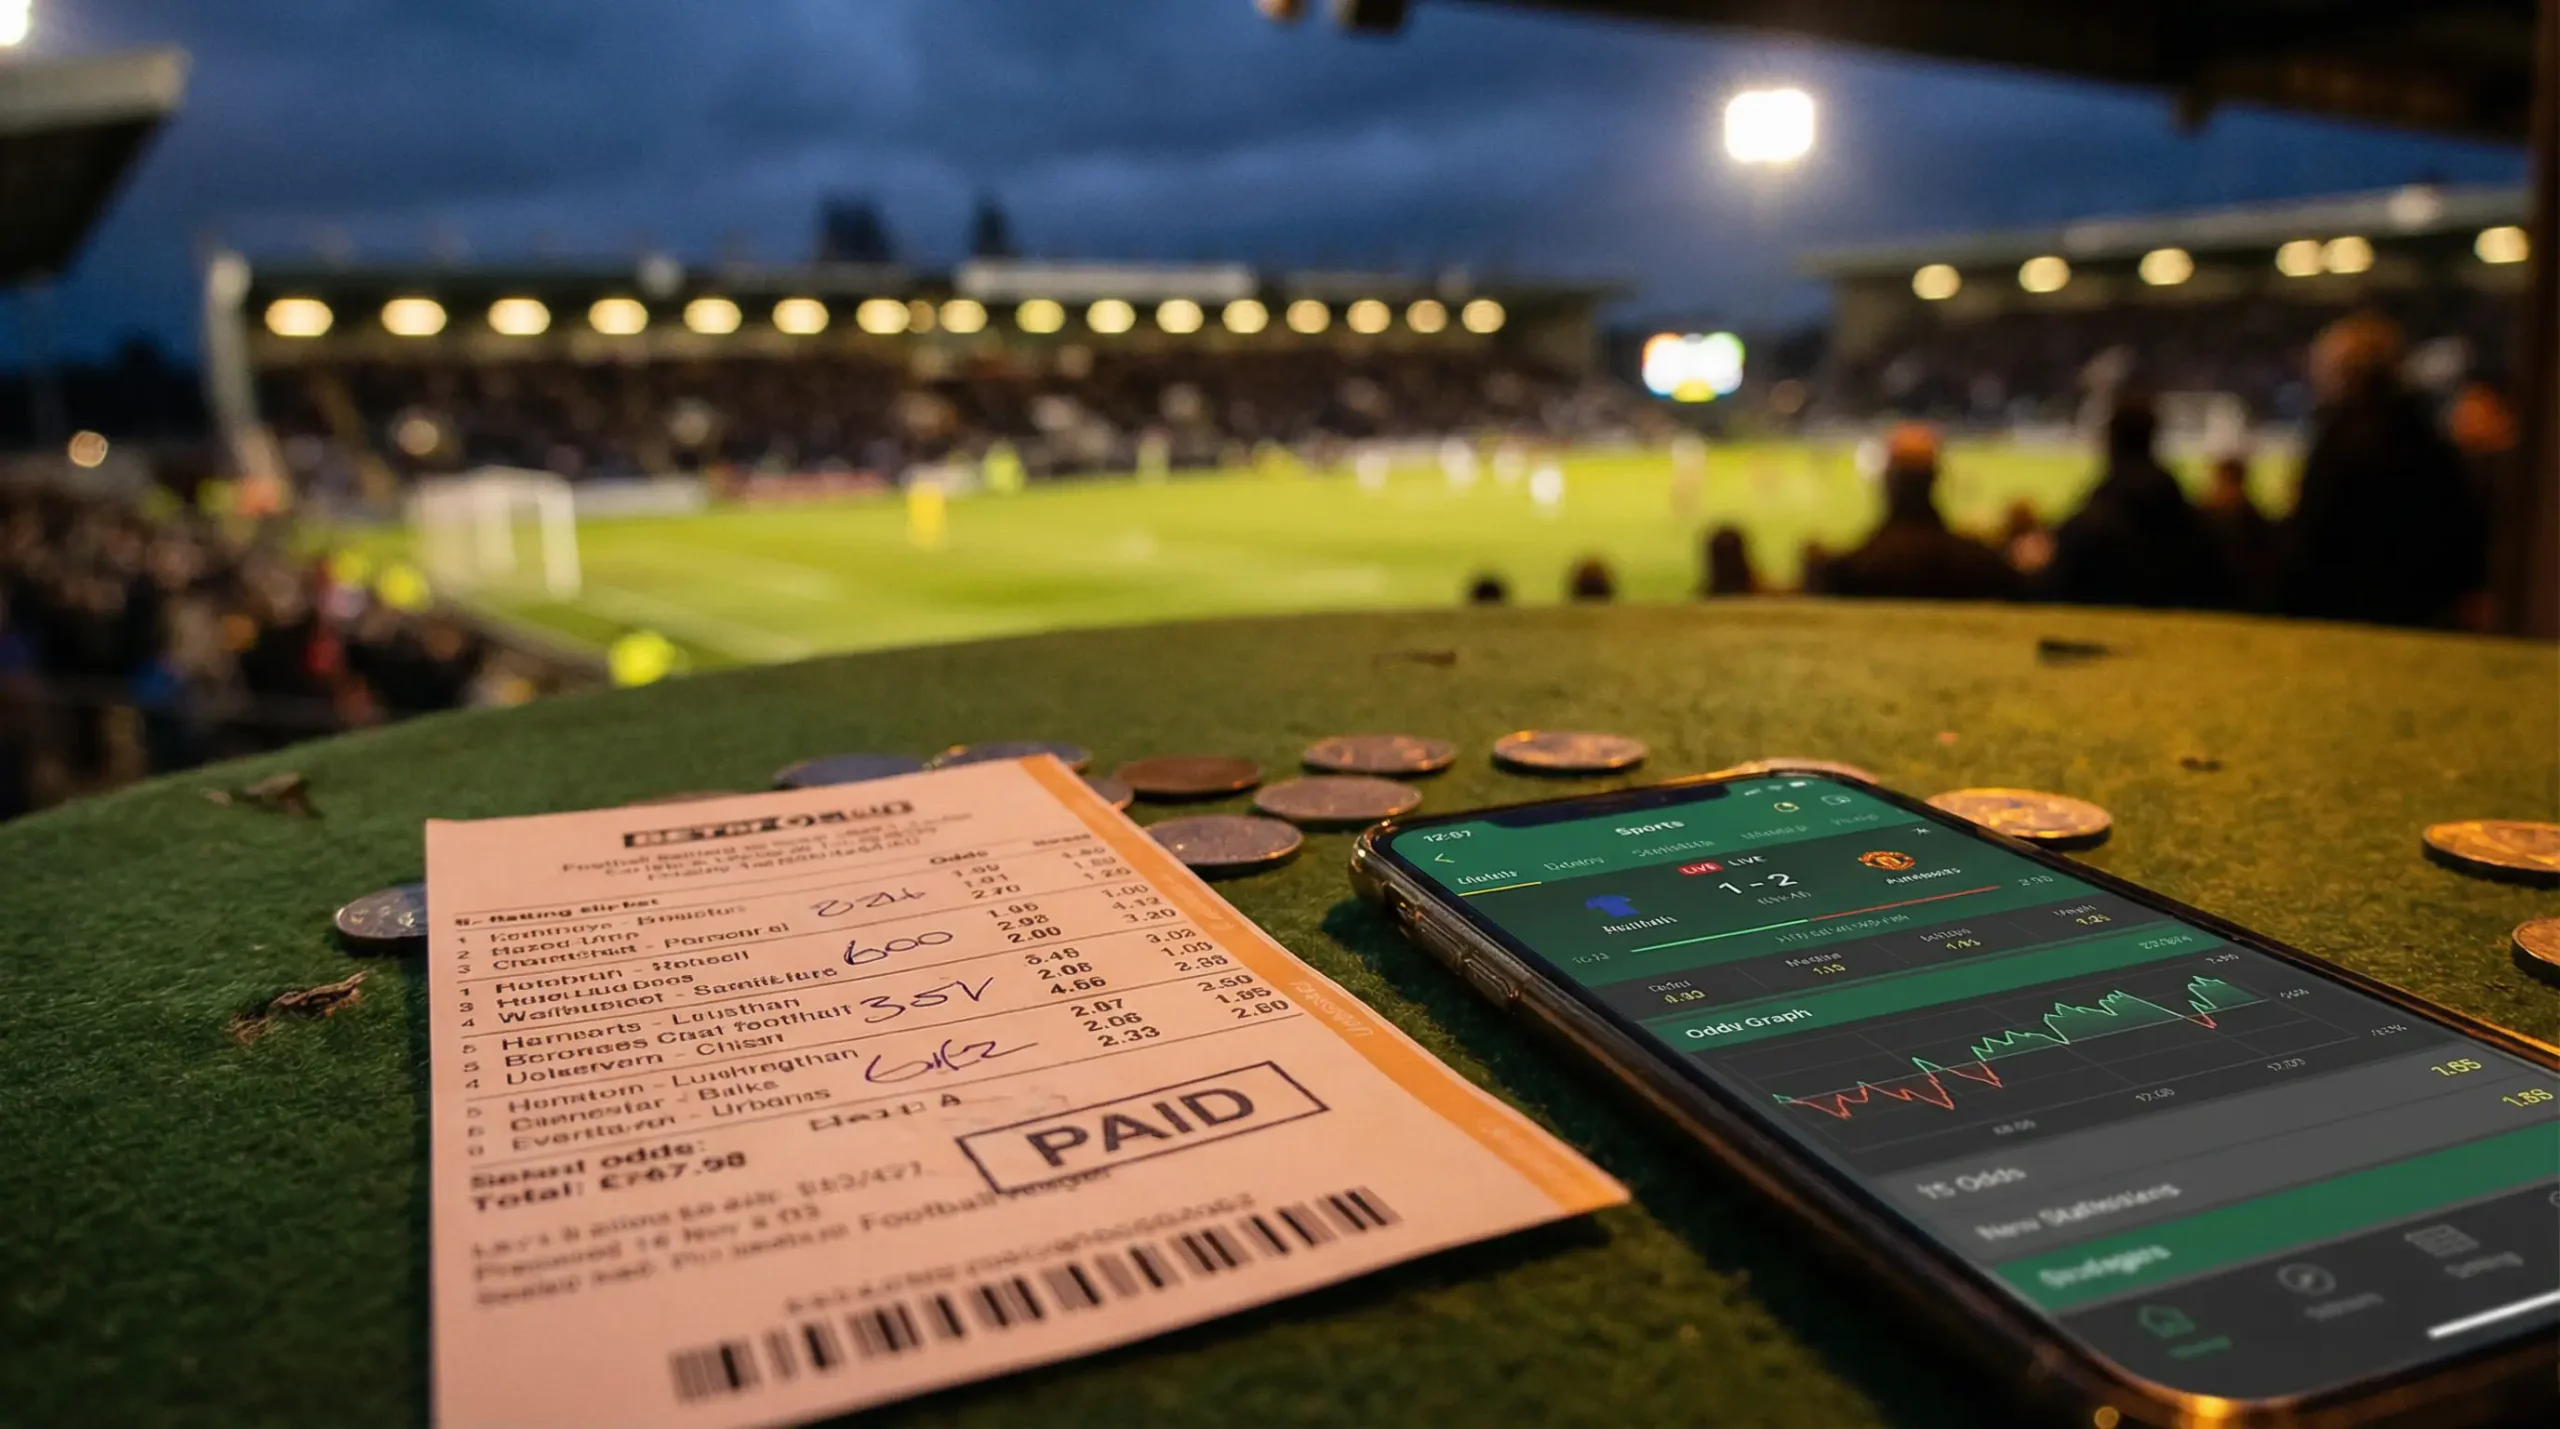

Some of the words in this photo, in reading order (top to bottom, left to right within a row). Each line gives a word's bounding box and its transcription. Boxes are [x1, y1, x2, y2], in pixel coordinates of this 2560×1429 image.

[1614, 819, 1686, 838] Sports
[1727, 854, 1769, 868] LIVE
[1717, 881, 1743, 896] 1
[1766, 872, 1799, 888] 2
[1007, 926, 1061, 943] 2.00
[1745, 1007, 1814, 1028] Graph
[2430, 1058, 2482, 1077] 1.65
[1025, 1088, 1255, 1168] PAID
